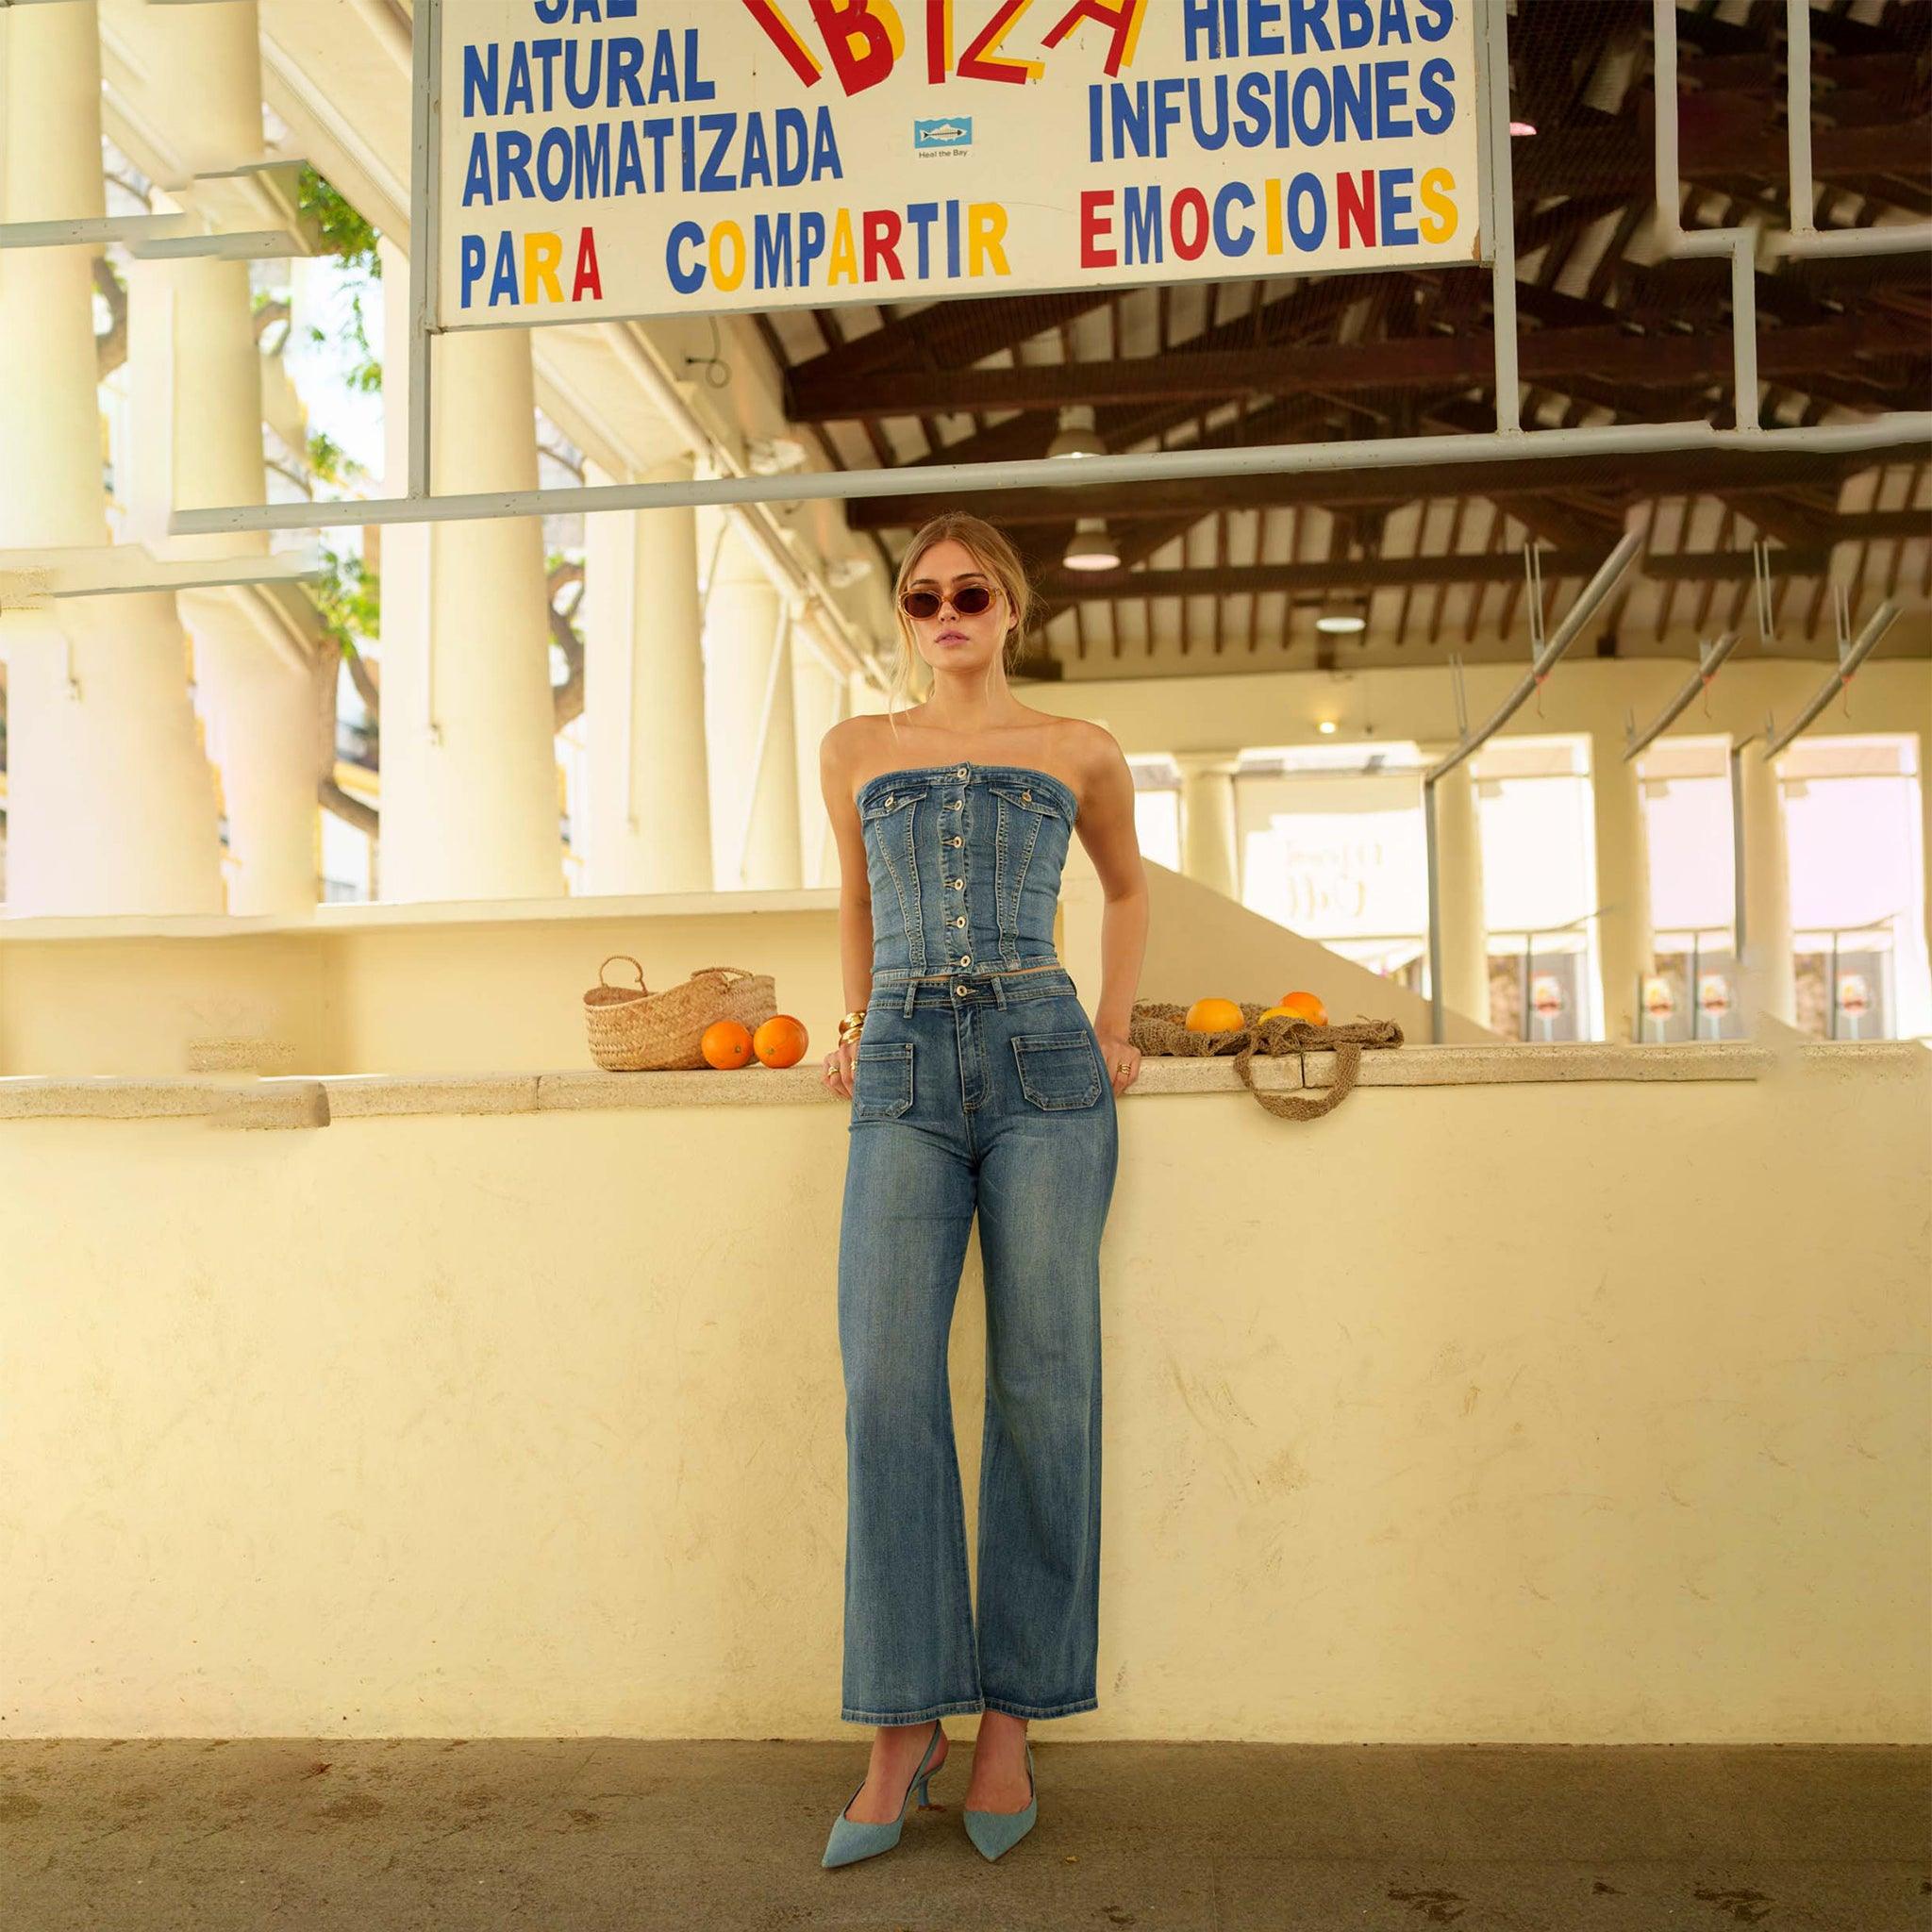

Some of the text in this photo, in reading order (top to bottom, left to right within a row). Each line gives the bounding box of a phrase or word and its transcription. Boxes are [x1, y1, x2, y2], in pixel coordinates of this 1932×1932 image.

[463, 28, 716, 118] NATURAL
[1184, 0, 1454, 61] HIERBAS
[461, 105, 843, 207] AROMATIZADA
[953, 149, 967, 158] Bay
[1089, 57, 1456, 162] INFUSIONES
[460, 167, 1459, 308] PARA COMPARTIR EMOCIONES
